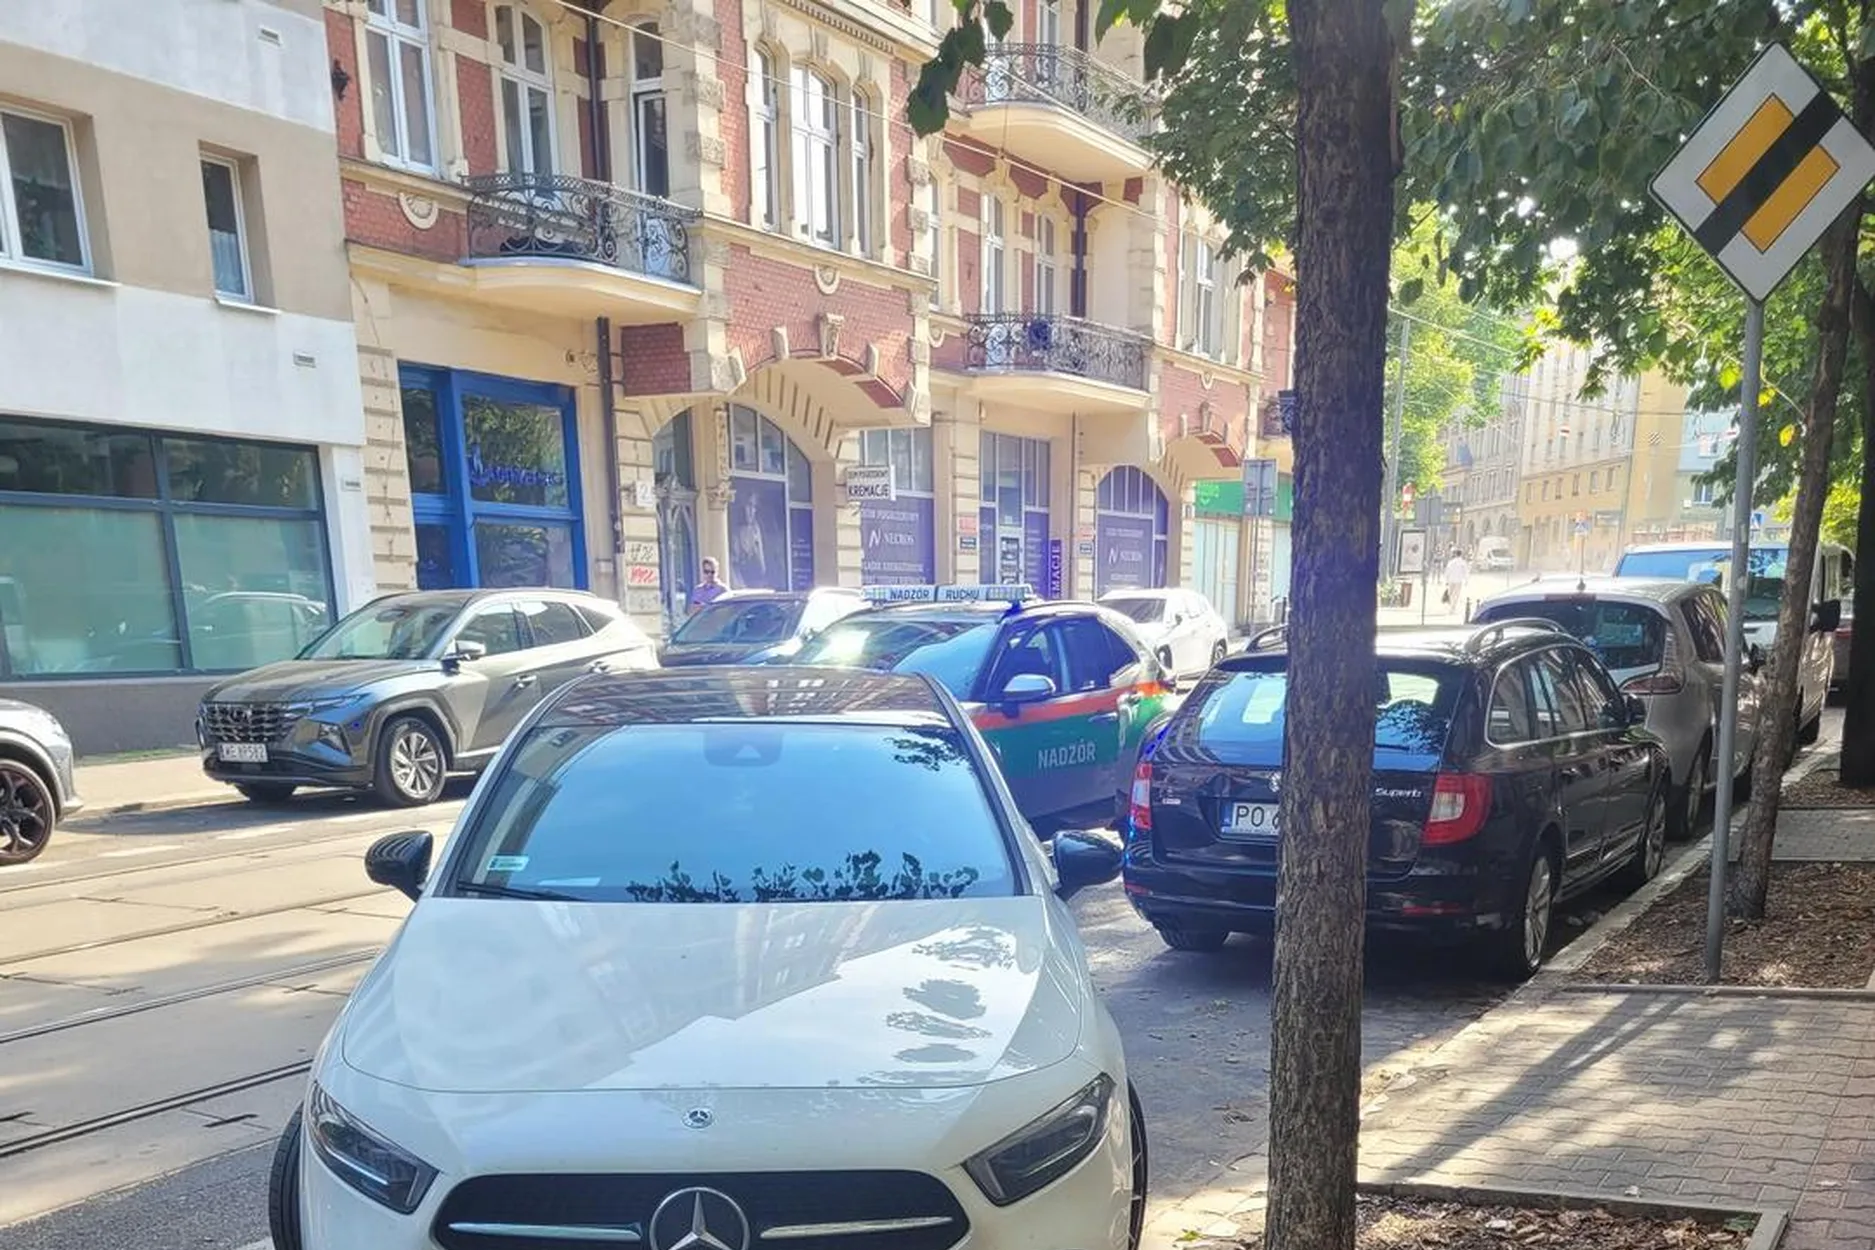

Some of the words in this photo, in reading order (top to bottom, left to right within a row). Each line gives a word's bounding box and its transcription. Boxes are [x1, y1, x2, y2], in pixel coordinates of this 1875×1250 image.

[848, 483, 889, 497] KREMACJE
[945, 588, 980, 600] RUCHU
[1038, 737, 1096, 769] NADZÓR
[1375, 787, 1422, 798] Superb
[1235, 804, 1265, 828] PO
